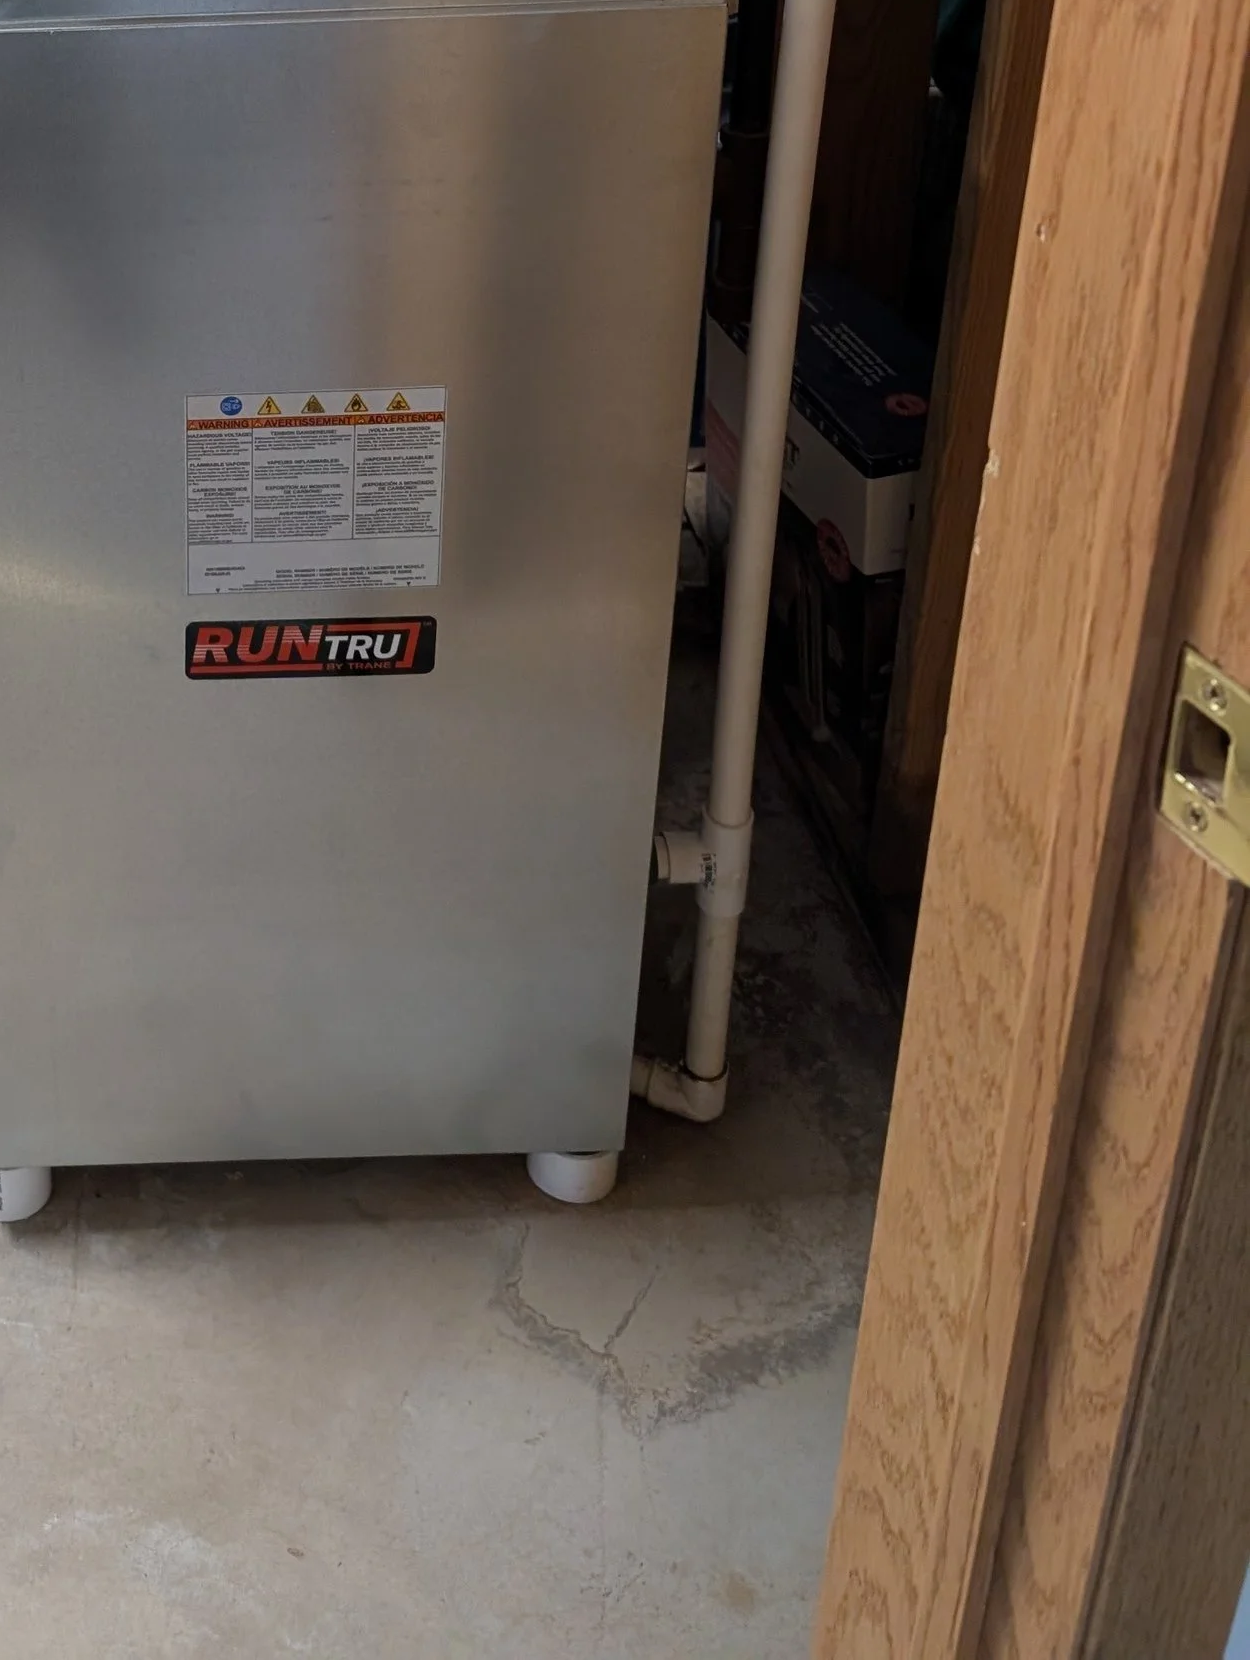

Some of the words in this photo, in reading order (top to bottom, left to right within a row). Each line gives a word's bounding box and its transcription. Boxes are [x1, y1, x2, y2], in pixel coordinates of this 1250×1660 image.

[198, 419, 250, 430] WARNING
[263, 416, 351, 428] AVERTISSEMENT
[367, 413, 444, 425] ADVERTENCIA
[326, 662, 344, 671] BY
[349, 661, 391, 670] TRANE
